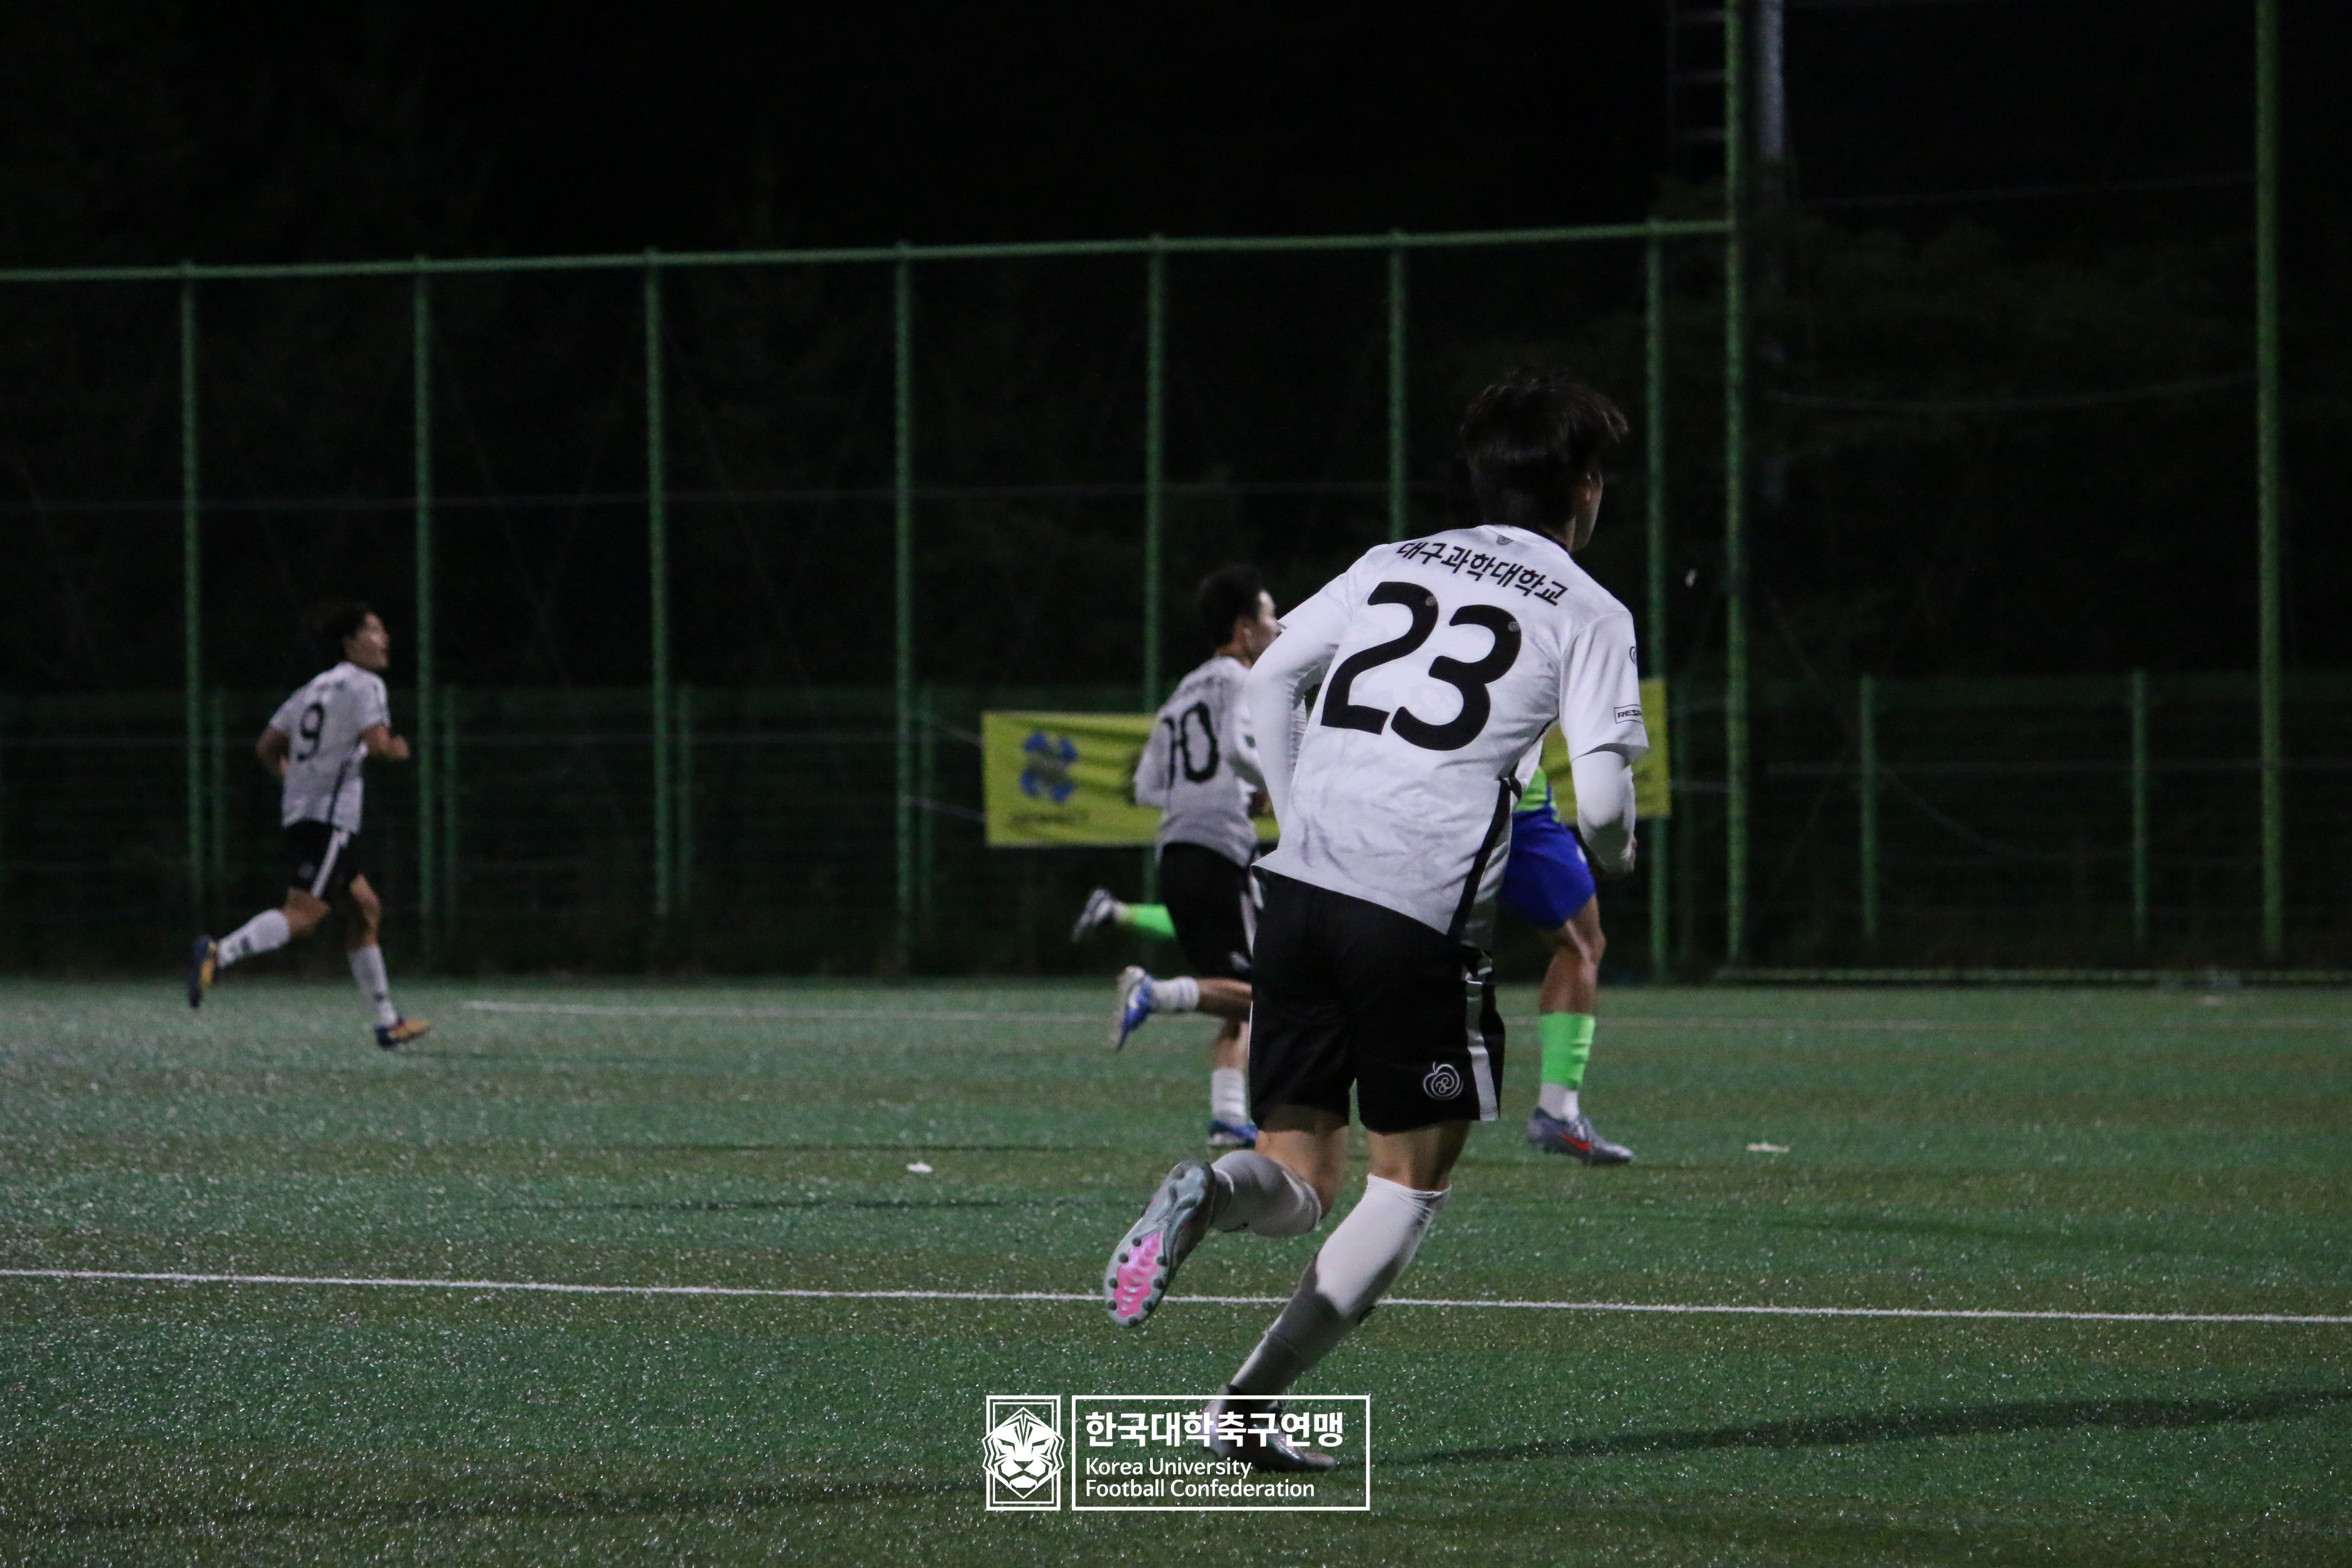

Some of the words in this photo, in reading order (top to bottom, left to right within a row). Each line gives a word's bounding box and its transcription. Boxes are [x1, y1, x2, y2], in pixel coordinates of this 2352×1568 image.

[1396, 542, 1569, 606] 대구과학대학교
[1321, 581, 1521, 751] 23
[298, 703, 324, 761] 9
